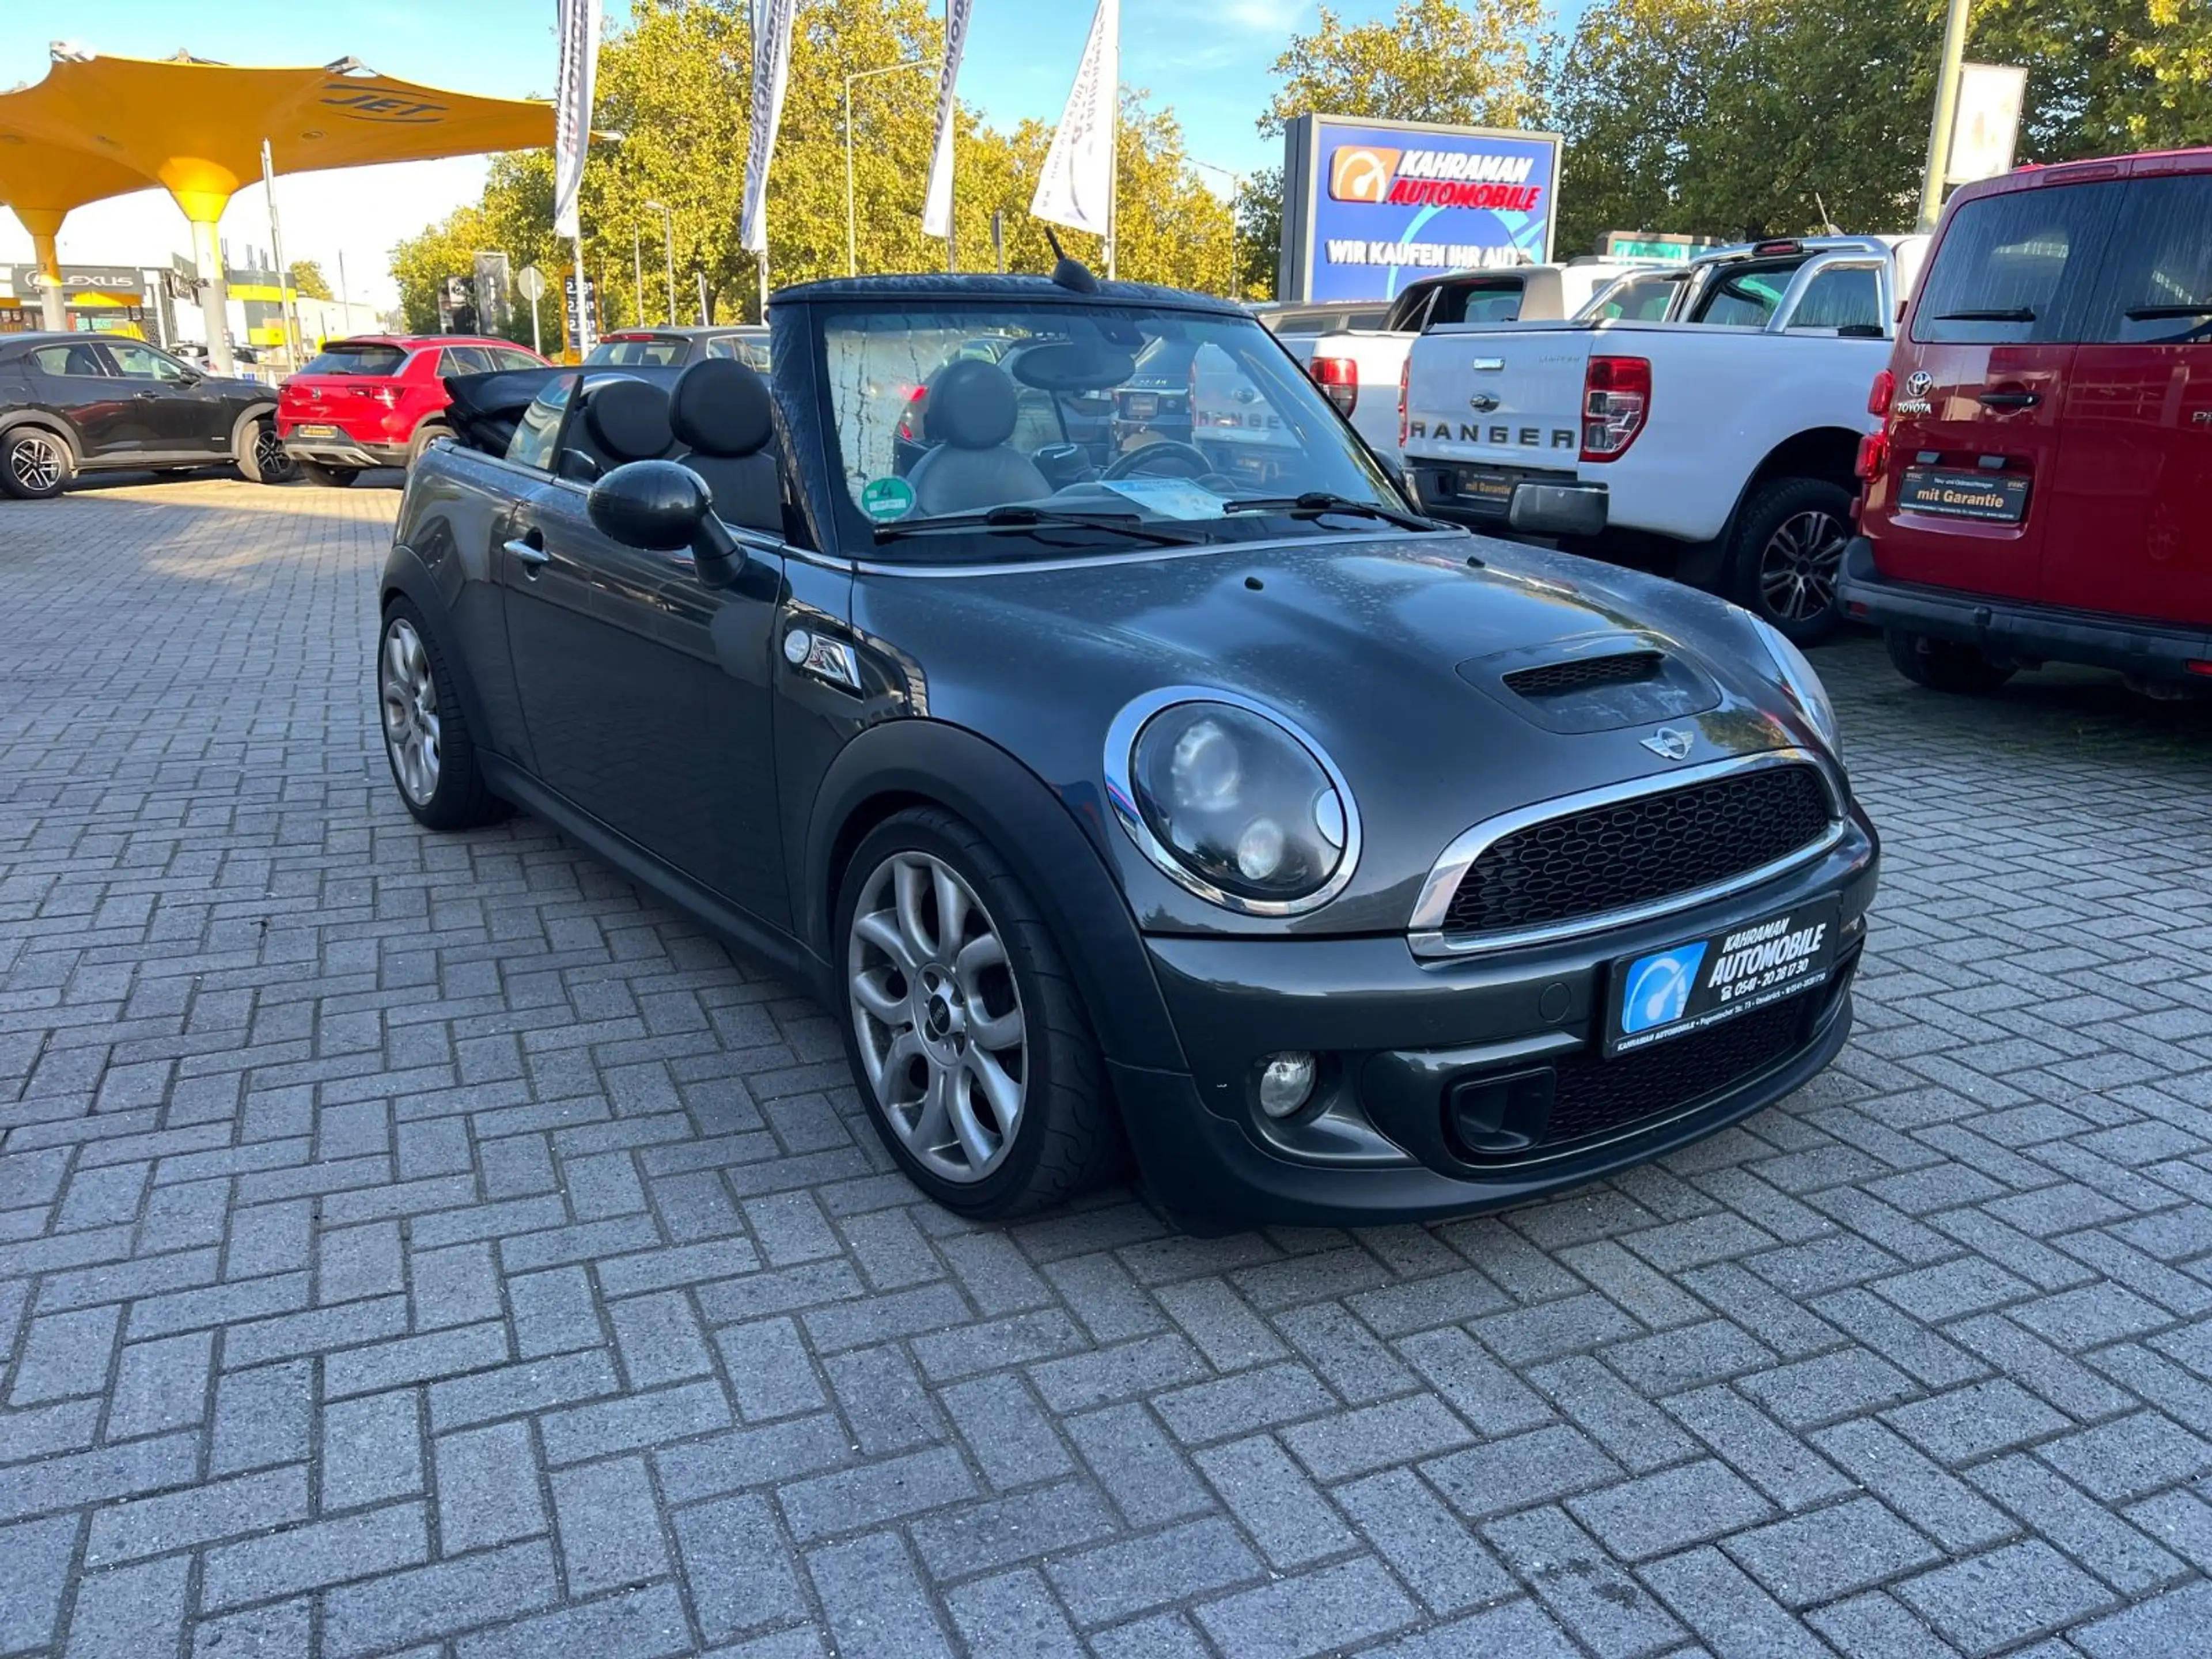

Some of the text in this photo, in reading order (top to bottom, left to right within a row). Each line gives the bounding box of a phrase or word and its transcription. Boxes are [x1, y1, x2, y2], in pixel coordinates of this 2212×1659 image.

[319, 94, 449, 116] JET
[1396, 150, 1534, 183] KAHRAMAN
[1388, 179, 1543, 211] AUTOMOBILE
[1328, 239, 1367, 264] WIR
[1369, 241, 1446, 267] KAUFEN
[1447, 245, 1481, 268] IHR
[1897, 403, 1931, 414] TOYOTA
[1410, 421, 1575, 449] RANGER
[880, 481, 893, 498] 4
[1916, 488, 2004, 509] mit Garantie
[1722, 917, 1791, 953] KAHRAMAN
[1707, 923, 1827, 988] AUTOMOBILE
[1734, 976, 1758, 996] 0541
[1762, 970, 1775, 987] 20
[1787, 962, 1797, 977] 17
[1795, 958, 1809, 974] 30
[1654, 1020, 1696, 1040] AUTOMOBILE
